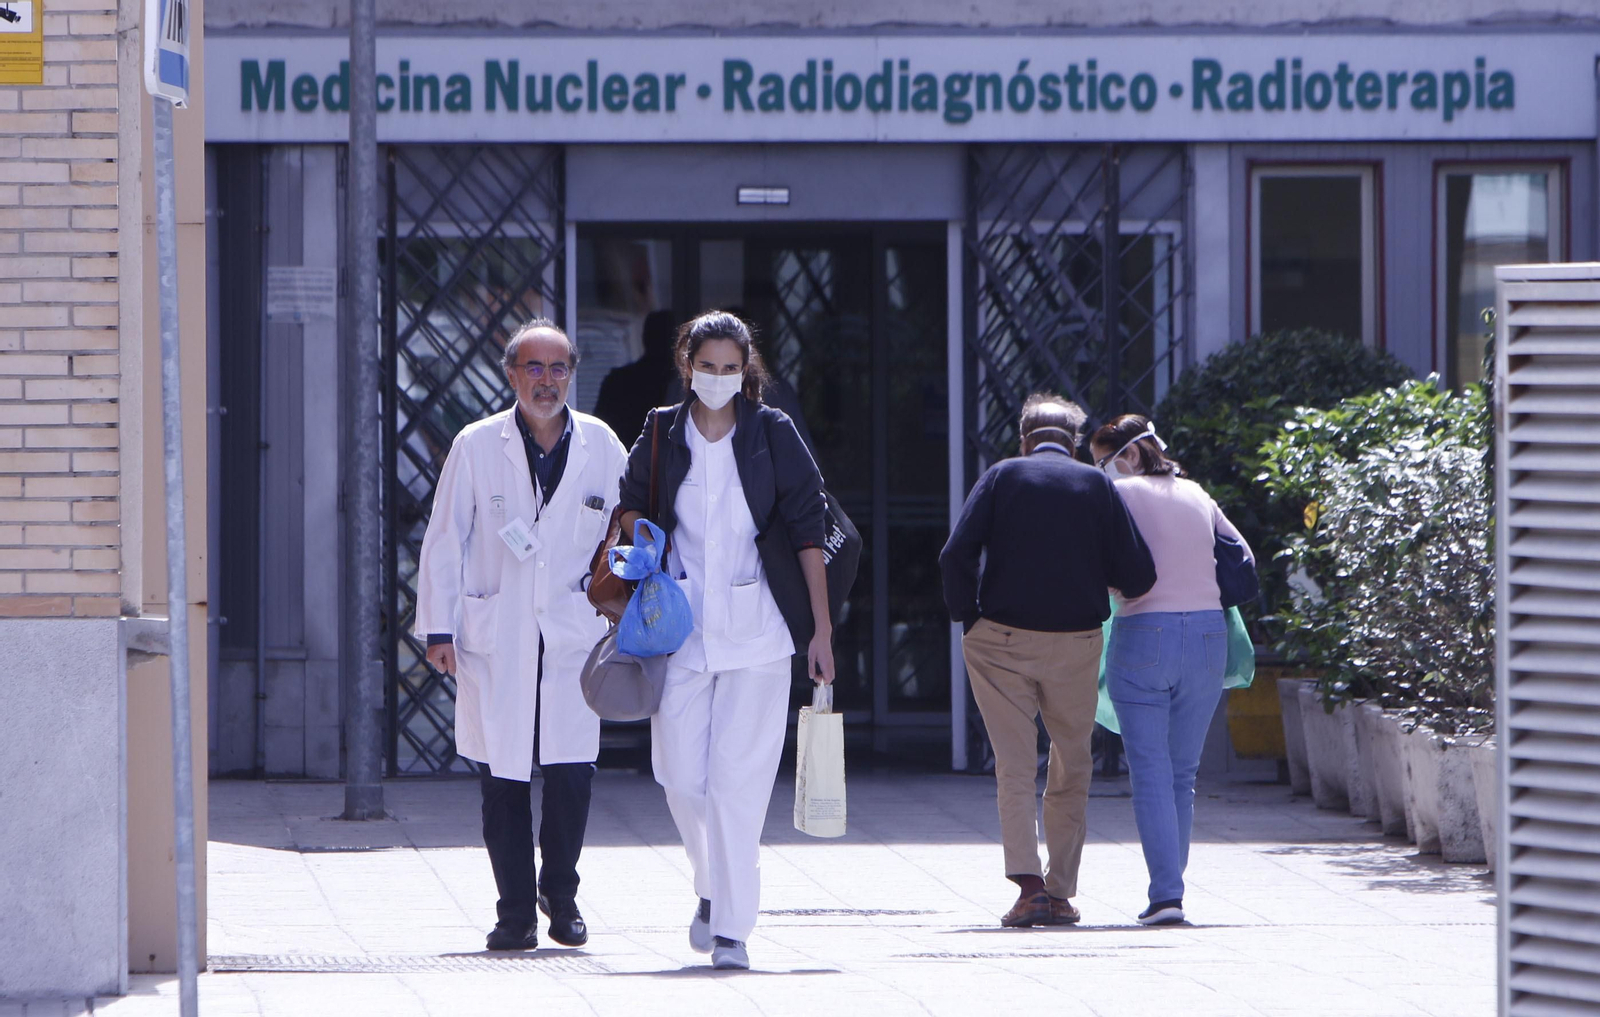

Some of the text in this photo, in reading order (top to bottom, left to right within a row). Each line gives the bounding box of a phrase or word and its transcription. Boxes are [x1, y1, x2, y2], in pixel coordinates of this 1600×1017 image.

[241, 55, 1516, 124] Medcina Nuclear Radiodiagnóstico Radioterapia
